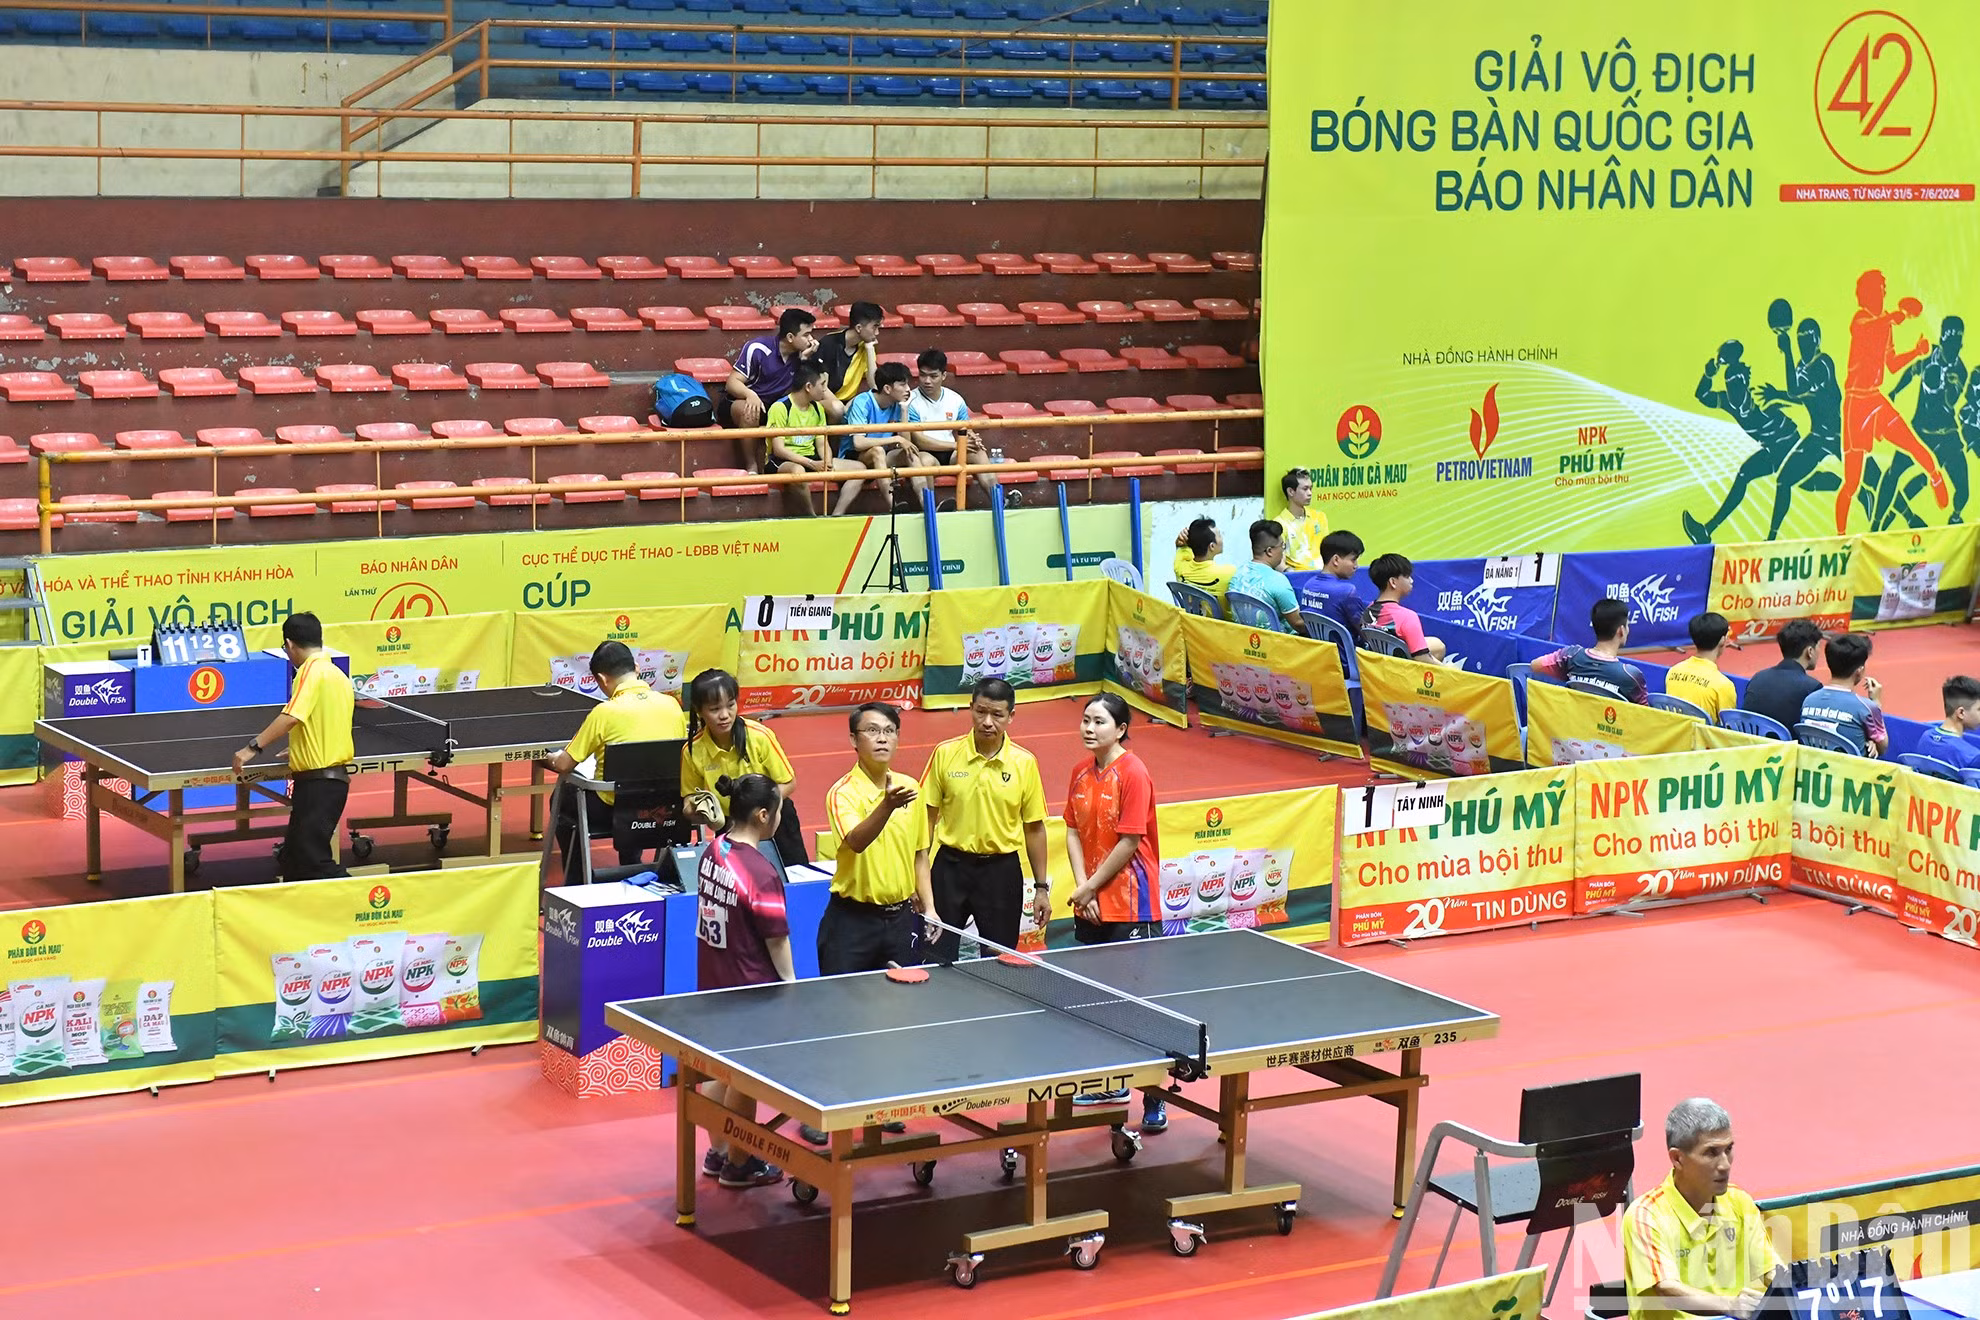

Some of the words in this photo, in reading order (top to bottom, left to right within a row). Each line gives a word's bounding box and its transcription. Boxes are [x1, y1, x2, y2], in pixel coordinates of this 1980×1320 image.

[1475, 34, 1562, 92] GIẢI
[1580, 37, 1636, 93] VÔ
[1652, 52, 1755, 103] ĐỊCH
[1826, 33, 1913, 136] 42
[1310, 95, 1437, 152] BÓNG
[1451, 96, 1540, 151] BÀN
[1554, 89, 1673, 152] QUỐC
[1686, 111, 1754, 151] GIA
[1436, 156, 1523, 211] BÁO
[1538, 154, 1655, 211] NHÂN
[1670, 153, 1753, 209] DÂN
[1796, 188, 1817, 199] NHA
[1819, 188, 1851, 201] TRANG,
[1868, 186, 1892, 199] NGÀY
[1893, 188, 1912, 199] 31/5
[1920, 188, 1960, 199] 7/6/2024
[1403, 350, 1431, 366] NHÀ
[1435, 346, 1474, 365] ĐỒNG
[1477, 346, 1515, 363] HÀNH
[1517, 345, 1559, 361] CHÍNH
[1578, 426, 1608, 446] NPK
[1436, 457, 1533, 483] PETROVIETNAM
[1559, 449, 1594, 474] PHÚ
[1600, 446, 1625, 472] MỸ
[1311, 466, 1339, 488] PHÂN
[1342, 463, 1364, 486] BÓN
[1367, 462, 1382, 486] CÀ
[1385, 463, 1408, 484] MAU
[1554, 475, 1575, 488] Cho
[1613, 473, 1629, 484] thu
[361, 560, 387, 575] BÁO
[391, 557, 428, 573] NHÂN
[431, 555, 459, 571] DÂN
[522, 554, 549, 567] CỤC
[554, 546, 578, 564] THỂ
[584, 551, 608, 566] DỤC
[611, 542, 636, 561] THỂ
[640, 547, 674, 559] THAO
[686, 545, 719, 557] LĐBB
[723, 540, 750, 557] VIỆT
[753, 542, 780, 553] NAM
[1722, 558, 1763, 585] NPK
[1768, 548, 1812, 582] PHÚ
[1818, 545, 1852, 578] MỸ
[78, 574, 97, 591] VÀ
[101, 569, 130, 589] THỂ
[135, 573, 173, 588] THAO
[176, 568, 212, 586] TỈNH
[214, 565, 262, 583] KHÁNH
[265, 563, 294, 580] HÒA
[1533, 553, 1545, 583] 1
[522, 572, 591, 610] CÚP
[1721, 594, 1753, 611] Cho
[1758, 591, 1791, 609] mùa
[1795, 588, 1820, 606] bội
[1823, 586, 1847, 602] thu
[62, 597, 134, 639] GIẢI
[758, 597, 775, 627] 0
[808, 605, 832, 617] GIANG
[1489, 615, 1518, 631] FISH
[1653, 606, 1680, 622] FISH
[141, 648, 149, 661] T
[162, 635, 190, 663] 11
[190, 635, 199, 650] 1
[201, 634, 215, 649] 2
[217, 633, 241, 660] 8
[755, 653, 799, 673] Cho
[806, 652, 854, 672] mùa
[861, 651, 894, 673] bội
[196, 670, 218, 700] 9
[785, 685, 827, 709] 20
[848, 689, 877, 702] TIN
[69, 697, 99, 707] Double
[1591, 779, 1650, 820] NPK
[1658, 762, 1724, 813] PHÚ
[1735, 755, 1785, 805] MỸ
[1841, 773, 1895, 820] MỸ
[1361, 785, 1376, 828] 1
[1397, 795, 1417, 812] TÂY
[1419, 795, 1444, 810] NINH
[1513, 779, 1567, 831] MỸ
[631, 821, 656, 830] DOUBLE
[662, 820, 676, 828] FISH
[1907, 795, 1962, 847] NPK
[1593, 832, 1643, 857] Cho
[1650, 827, 1696, 853] mùa
[1704, 820, 1740, 849] bội
[1747, 818, 1779, 841] thu
[1809, 819, 1845, 851] bội
[1853, 829, 1890, 858] thu
[1358, 861, 1410, 887] Cho
[1417, 854, 1471, 881] mùa
[1479, 846, 1519, 876] bội
[1527, 843, 1563, 868] thu
[1698, 873, 1729, 891] TIN
[1732, 862, 1783, 884] DÙNG
[1908, 849, 1950, 882] Cho
[1167, 887, 1192, 900] NPK
[1200, 877, 1226, 891] NPK
[1233, 877, 1256, 890] NPK
[1629, 869, 1674, 901] 20
[1802, 865, 1834, 889] TIN
[1836, 873, 1893, 903] DÙNG
[1403, 898, 1447, 936] 20
[1472, 899, 1505, 921] TIN
[1510, 889, 1567, 917] DÙNG
[1353, 919, 1370, 932] PHÚ
[1943, 905, 1978, 940] 20
[587, 935, 624, 948] Double
[637, 933, 659, 944] FISH
[321, 977, 351, 992] NPK
[363, 966, 394, 983] NPK
[406, 963, 435, 981] NPK
[283, 979, 312, 994] NPK
[24, 1007, 55, 1025] NPK
[66, 1017, 92, 1027] KALI
[144, 1013, 164, 1022] DAP
[1434, 1031, 1457, 1044] 235
[1027, 1073, 1134, 1102] MOFIT
[966, 1099, 992, 1110] Double
[993, 1097, 1010, 1106] FISH
[723, 1117, 765, 1150] DOUBLE
[767, 1142, 791, 1162] FISH
[1555, 1196, 1584, 1208] DOUBLE
[1841, 1226, 1865, 1243] NHÀ
[1867, 1220, 1898, 1238] ĐỒNG
[1901, 1216, 1932, 1234] HÀNH
[1934, 1210, 1969, 1226] CHÍNH
[1826, 1282, 1840, 1304] 0
[1844, 1278, 1855, 1300] 1
[1859, 1276, 1884, 1318] 7
